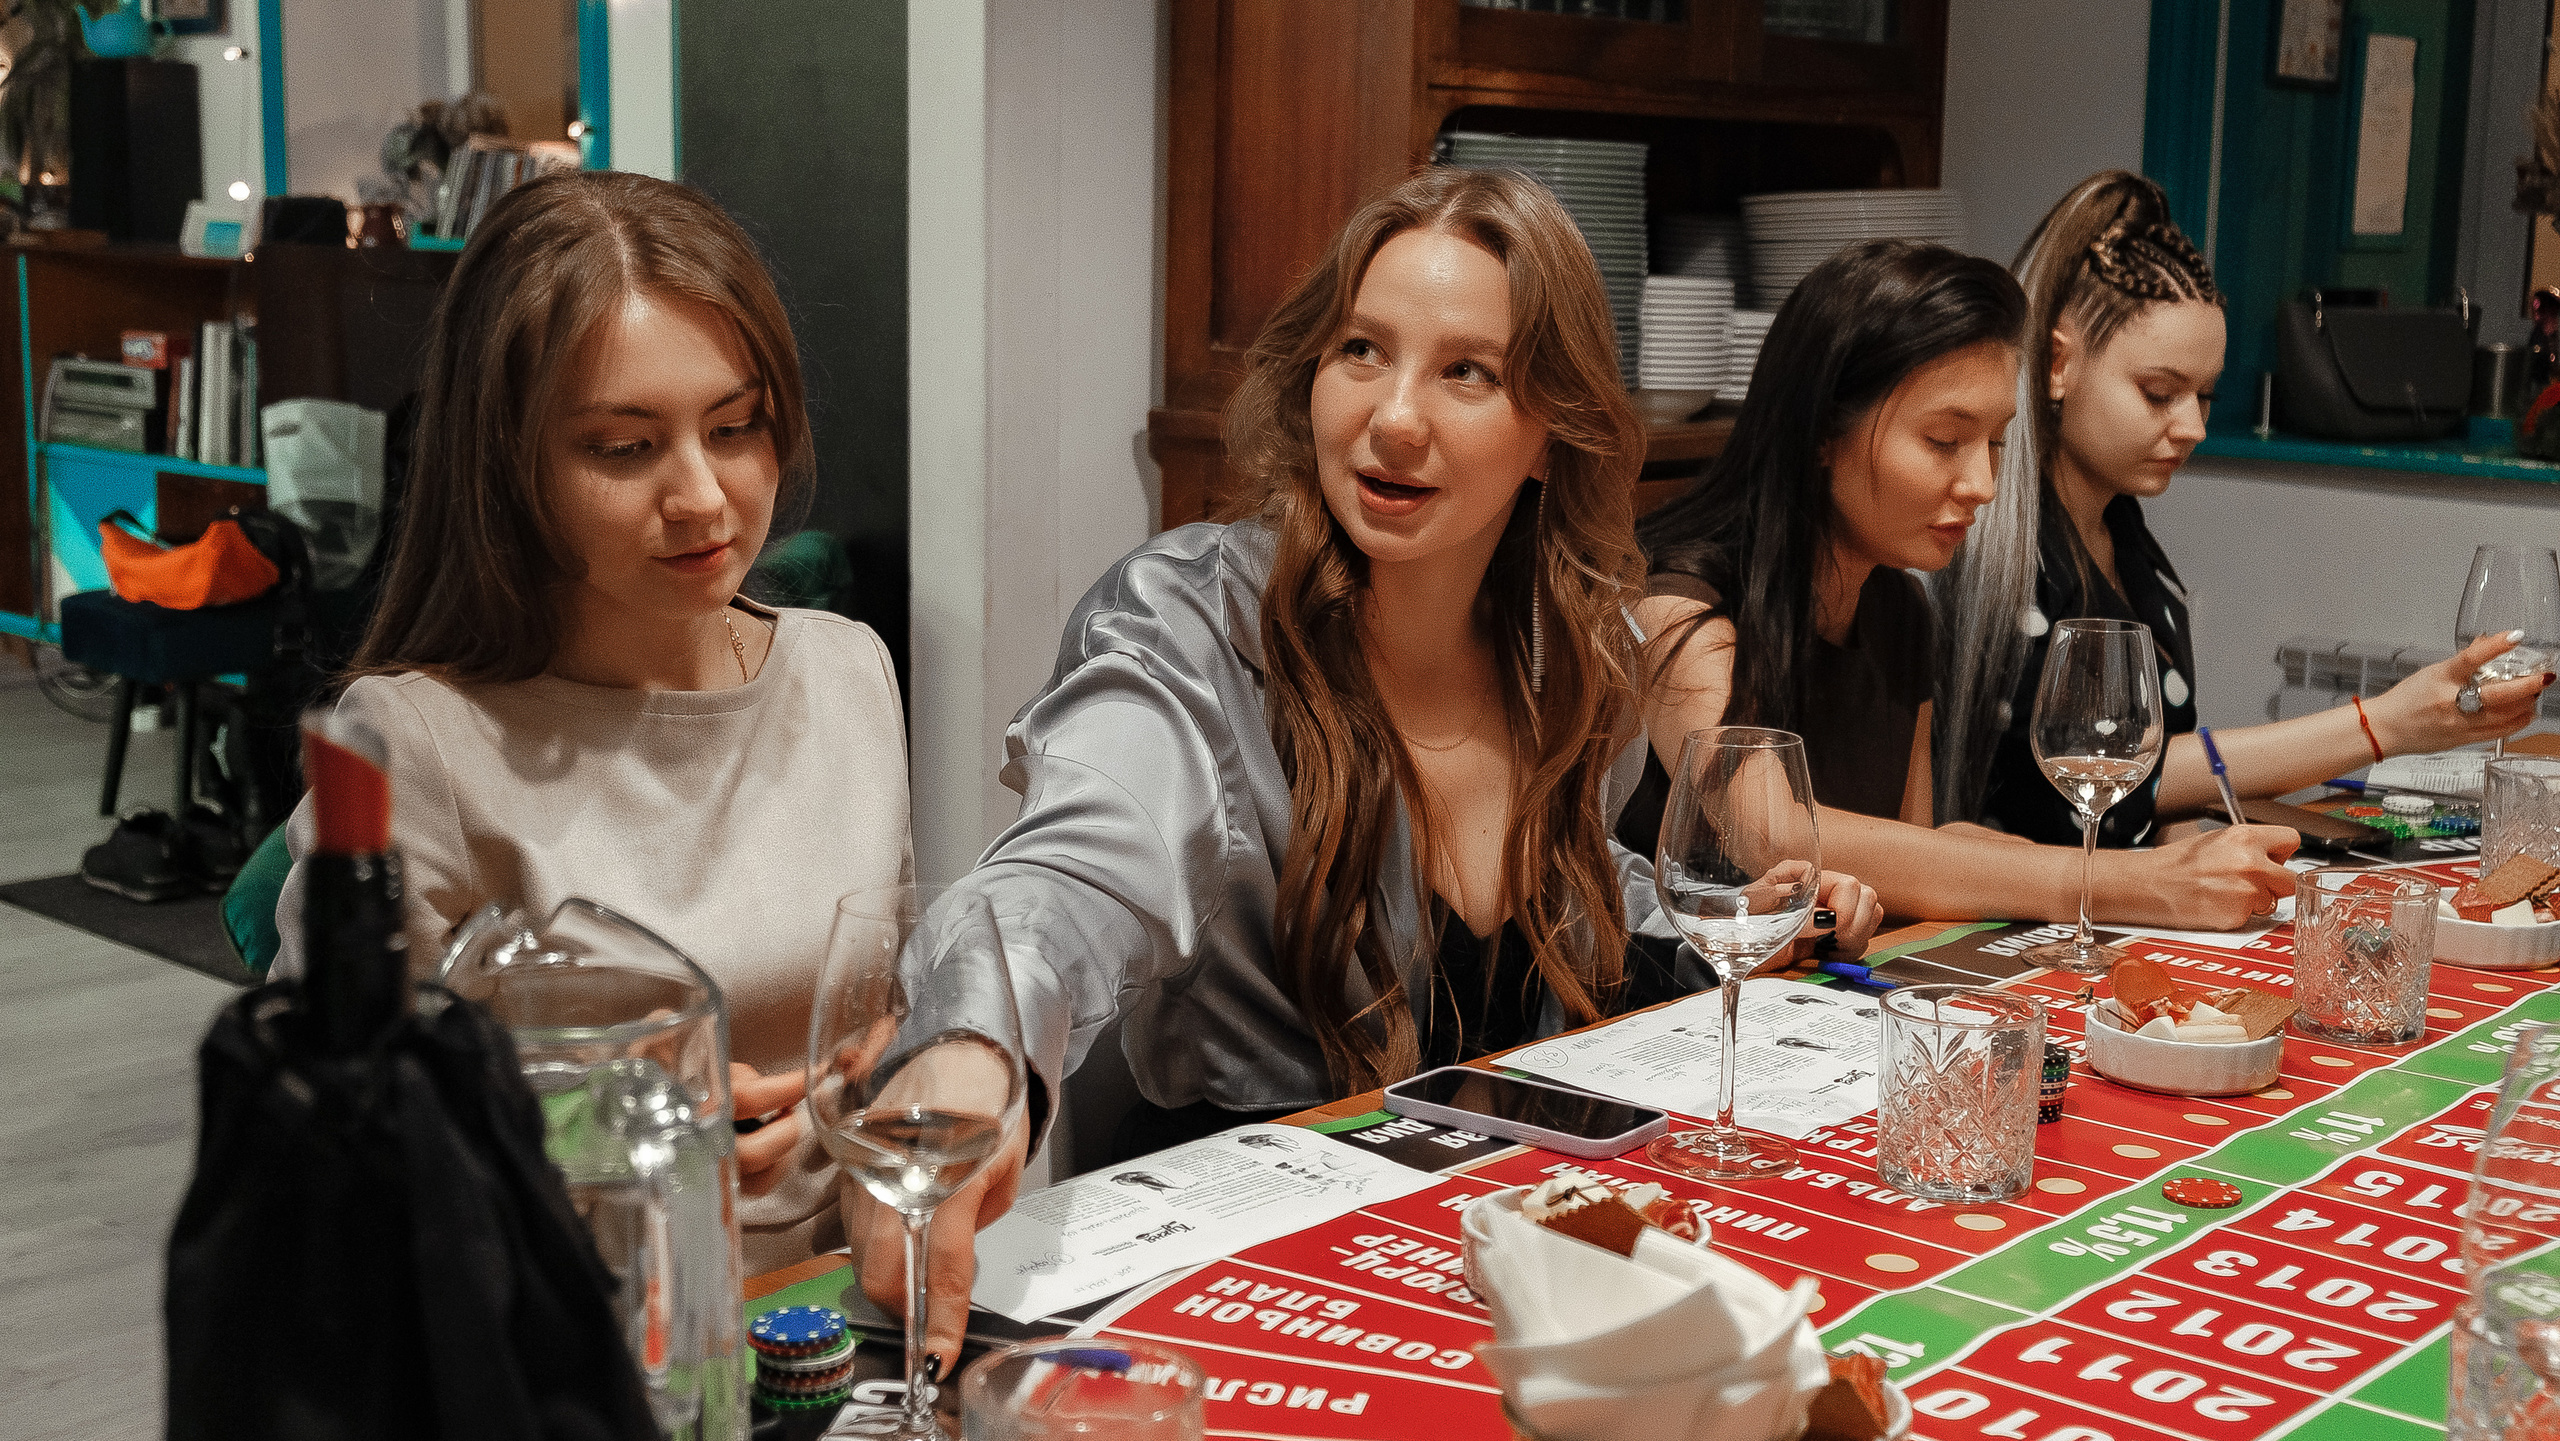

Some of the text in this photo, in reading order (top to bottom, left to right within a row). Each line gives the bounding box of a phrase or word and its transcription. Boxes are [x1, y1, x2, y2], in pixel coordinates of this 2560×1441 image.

[2145, 952, 2294, 987] ЦИТЕЛИ
[2289, 1111, 2384, 1146] 11%
[2048, 1204, 2189, 1263] 11,5%
[1205, 1275, 1363, 1320] БЛАН
[2193, 1249, 2439, 1322] 2013
[1172, 1293, 1476, 1370] СОВИНЬОН
[2104, 1288, 2362, 1373] 2012
[2017, 1336, 2278, 1423] 2011
